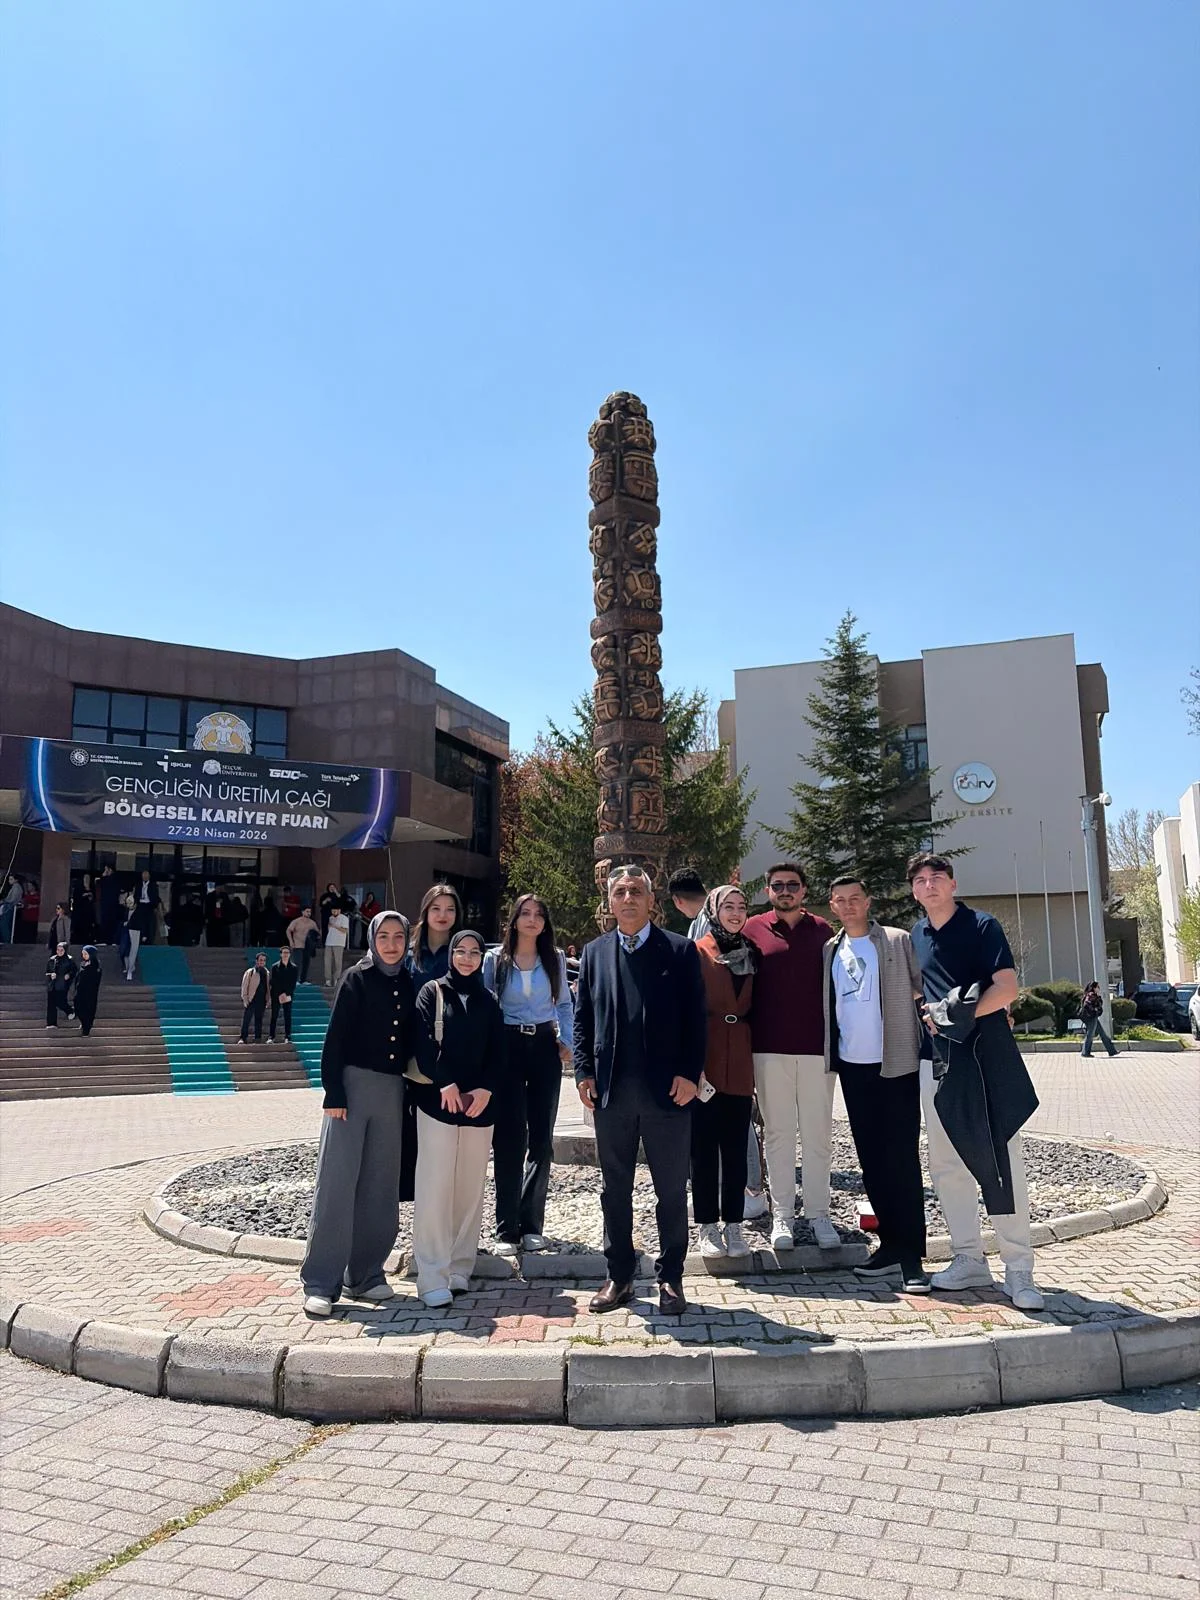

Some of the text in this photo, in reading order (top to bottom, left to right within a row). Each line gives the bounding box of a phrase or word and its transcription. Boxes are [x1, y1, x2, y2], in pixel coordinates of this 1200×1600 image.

[105, 776, 331, 809] GENÇLİĞİN ÜRETİM ÇAĞI
[103, 798, 329, 829] BÖLGESEL KARİYER FUARI
[168, 825, 268, 840] 27-28 Nisan 2026
